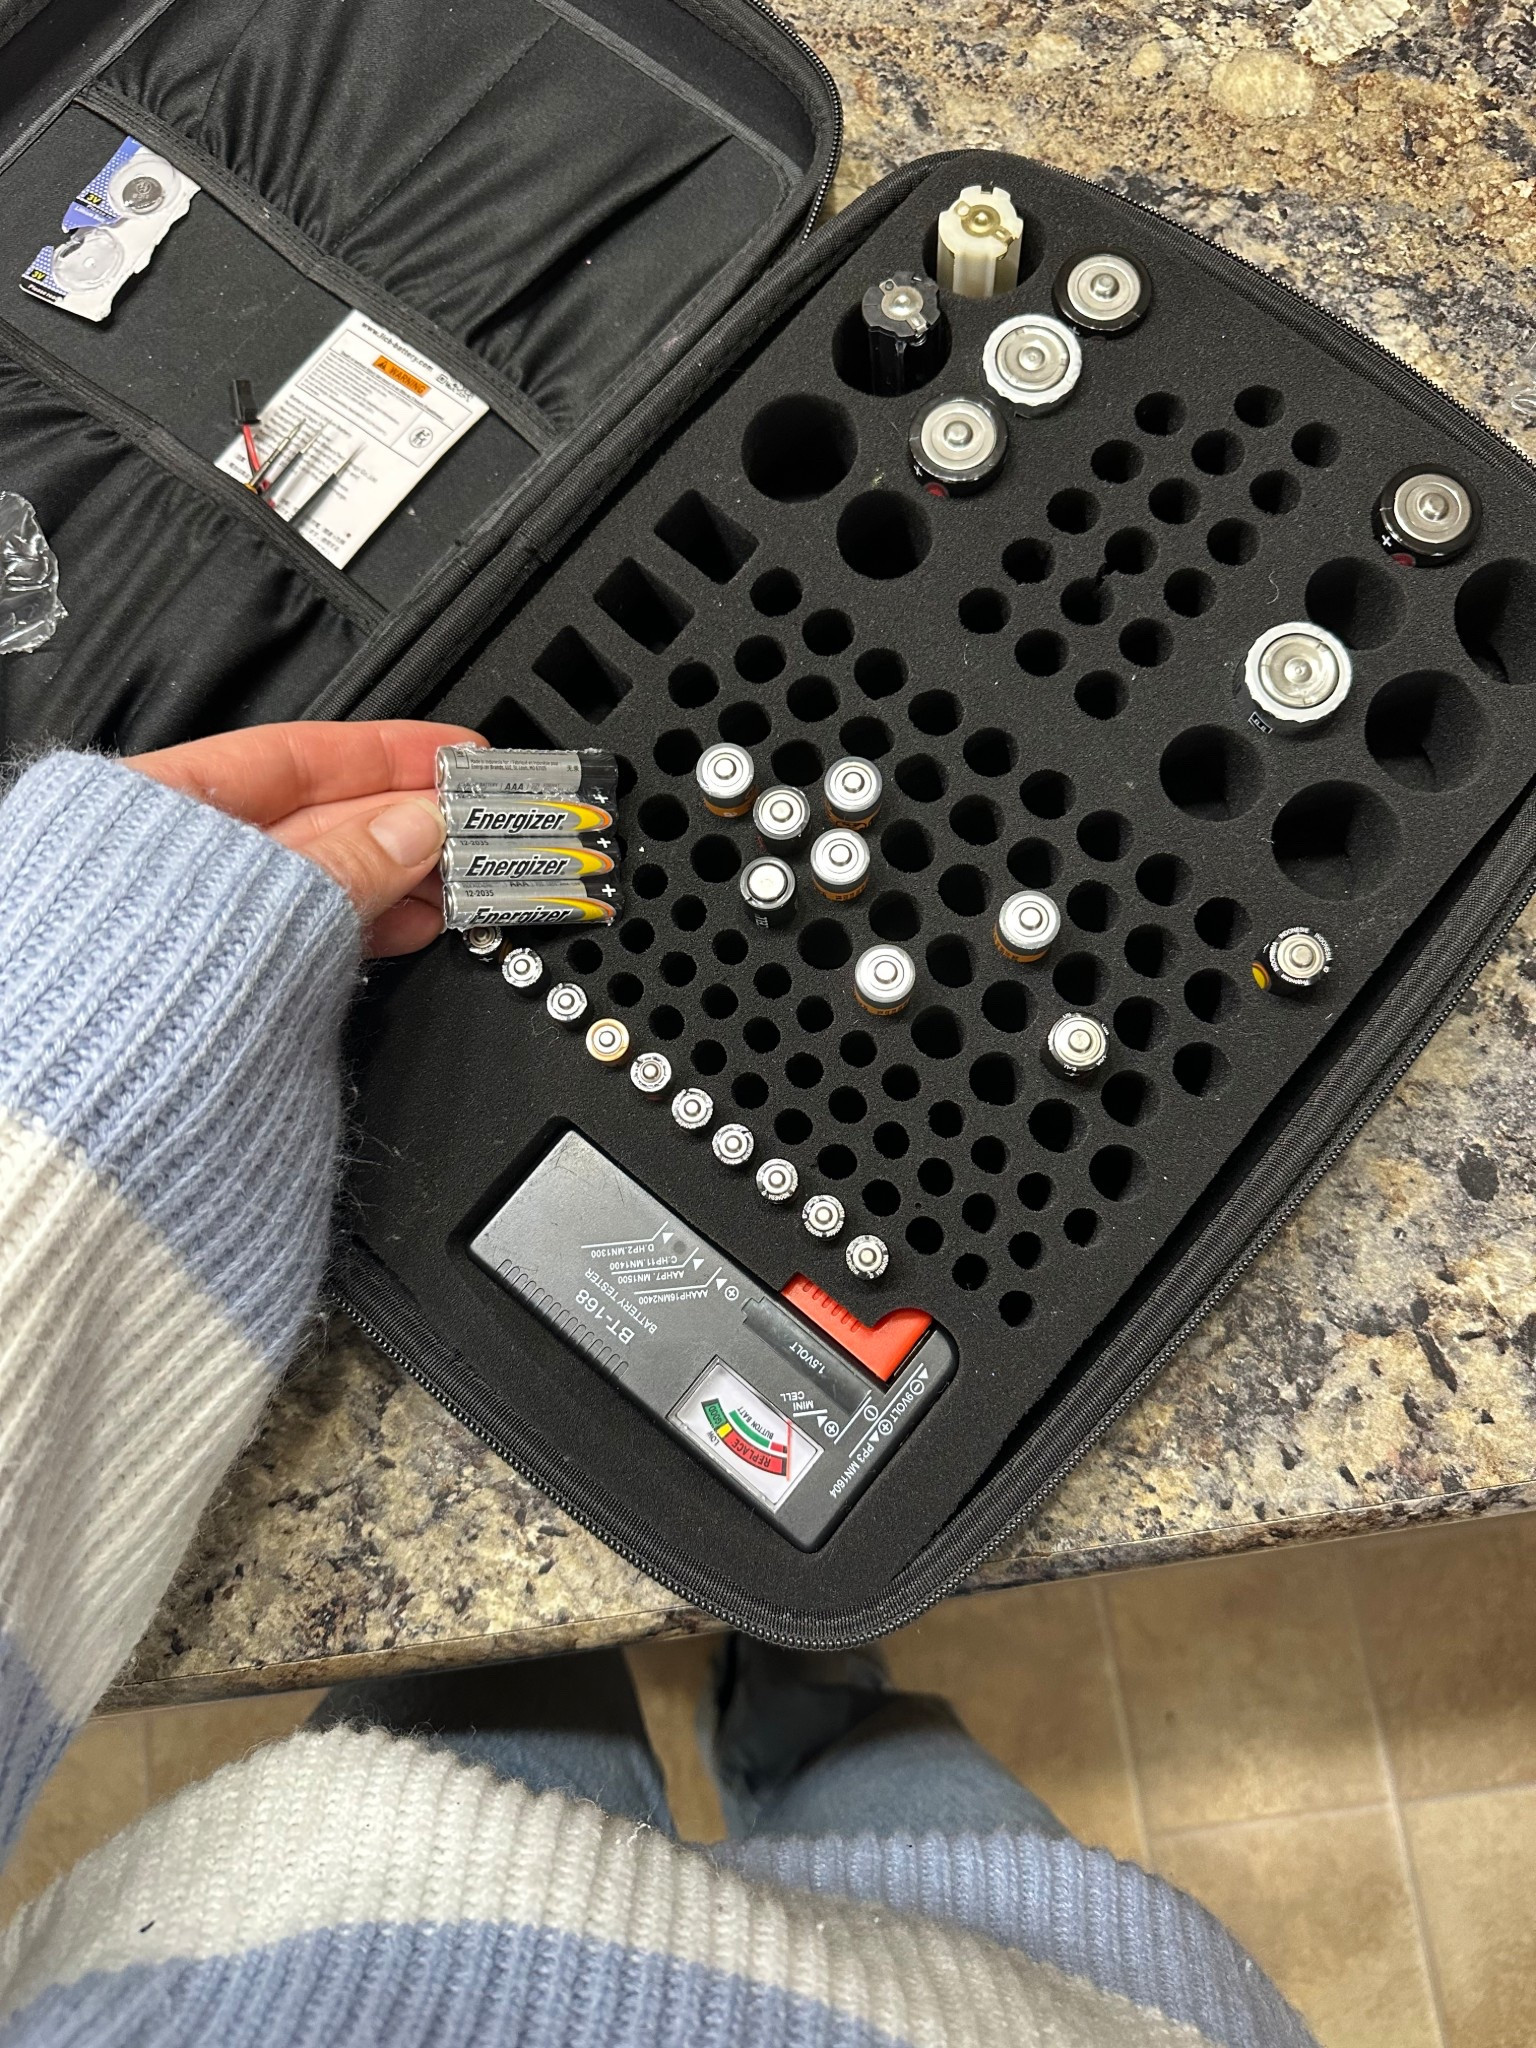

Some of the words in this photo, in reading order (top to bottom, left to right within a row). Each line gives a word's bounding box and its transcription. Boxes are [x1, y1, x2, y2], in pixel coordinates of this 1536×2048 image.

[86, 194, 102, 203] 3V
[31, 271, 45, 280] 3V
[28, 284, 47, 297] Please
[390, 367, 426, 395] WARNING
[505, 783, 524, 791] AAA
[463, 807, 568, 833] Energizer
[465, 855, 569, 878] Energizer
[470, 907, 573, 925] Energizer
[591, 1243, 655, 1259] D.HP2.MN1300
[609, 1255, 678, 1271] C.HP11.MN1400
[584, 1267, 619, 1301] TESTER
[617, 1273, 651, 1285] MN1500
[638, 1289, 709, 1305] AAAHP16MN2400
[575, 1289, 636, 1345] BT-168
[617, 1297, 658, 1335] BATTERY
[789, 1341, 826, 1375] 1.5VOLT
[780, 1390, 805, 1402] CELL
[737, 1406, 752, 1423] BATT
[792, 1400, 814, 1411] MINI
[892, 1390, 916, 1424] 9VOLT
[708, 1404, 722, 1426] GOOD
[706, 1430, 719, 1447] LOW
[751, 1421, 774, 1440] BUTTON
[731, 1437, 771, 1469] REPLACE
[856, 1441, 876, 1462] PP3
[829, 1460, 860, 1499] MN1604
